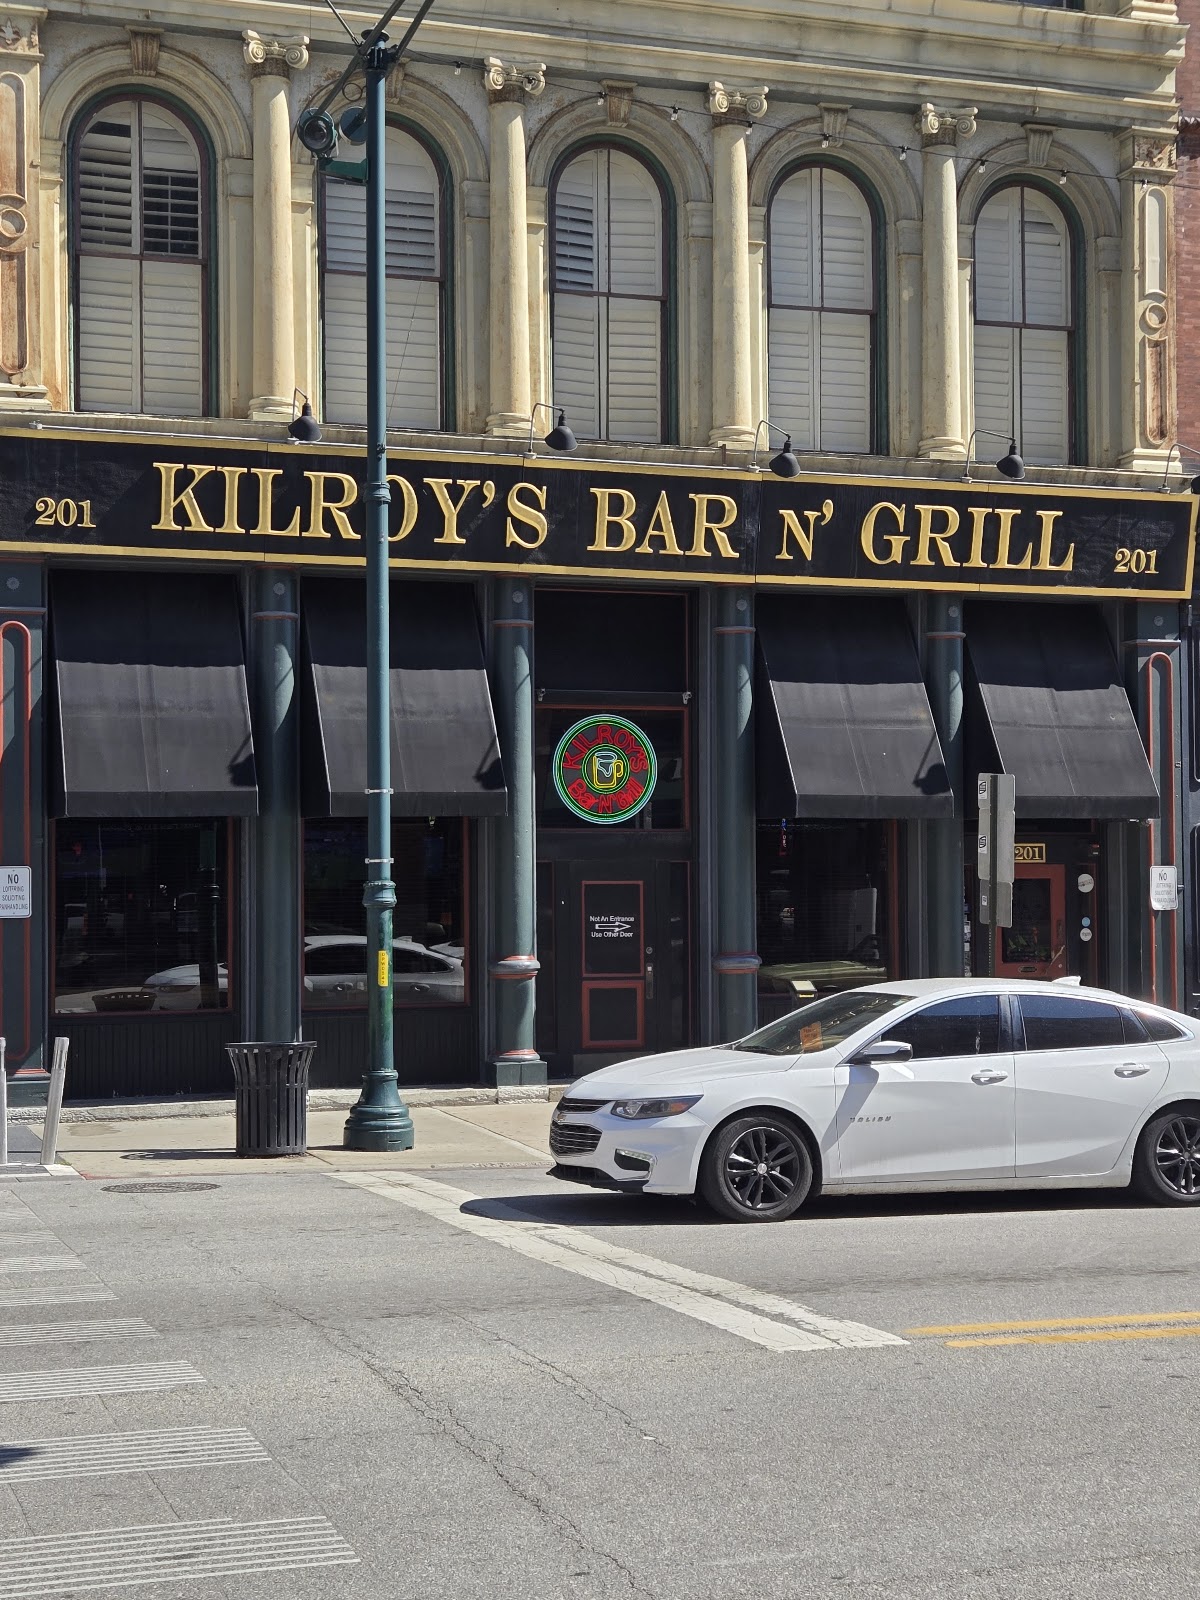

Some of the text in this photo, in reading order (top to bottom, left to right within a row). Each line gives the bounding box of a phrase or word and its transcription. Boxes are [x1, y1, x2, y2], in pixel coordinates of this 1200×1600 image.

[35, 496, 96, 528] 201
[152, 462, 1075, 572] KILROY'S BAR N' GRILL
[1114, 548, 1160, 575] 201
[1014, 846, 1042, 860] 201
[7, 874, 19, 884] NO
[1158, 872, 1168, 881] NO
